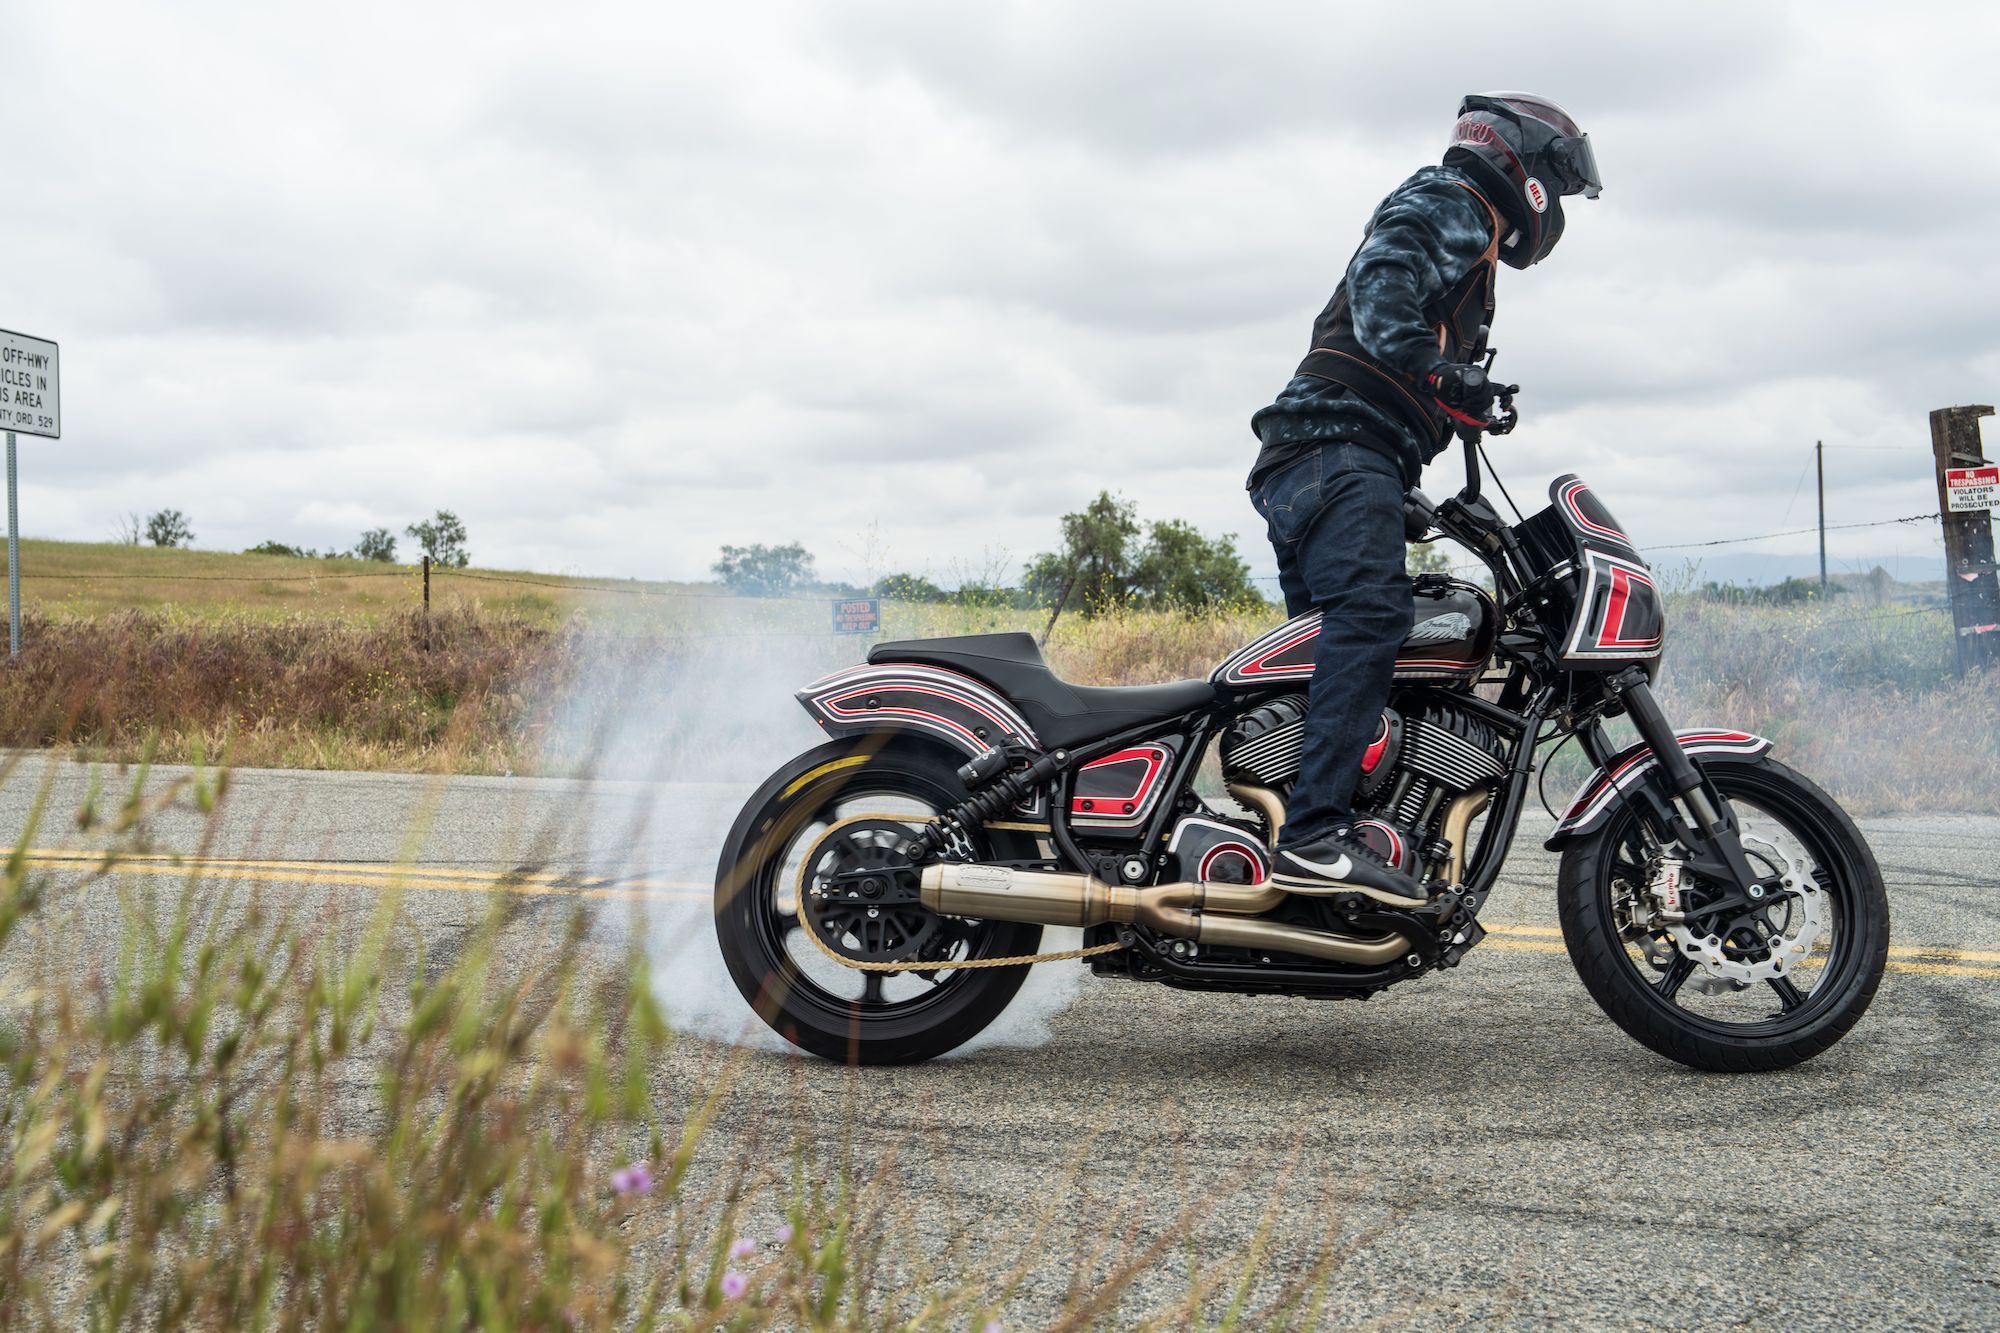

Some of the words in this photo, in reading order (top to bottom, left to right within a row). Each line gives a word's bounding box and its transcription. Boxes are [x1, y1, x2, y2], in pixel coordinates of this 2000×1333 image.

[1529, 183, 1543, 208] BELL
[3, 347, 49, 369] OFF-HWY
[36, 375, 47, 391] IN
[14, 390, 42, 408] AREA
[38, 415, 53, 428] 529
[1950, 475, 1996, 487] TRESPASSING
[1965, 470, 1975, 478] NO
[1953, 486, 1994, 495] VIOLATORS
[1951, 500, 2000, 509] PROSECUTED
[1668, 872, 1676, 905] brembo
